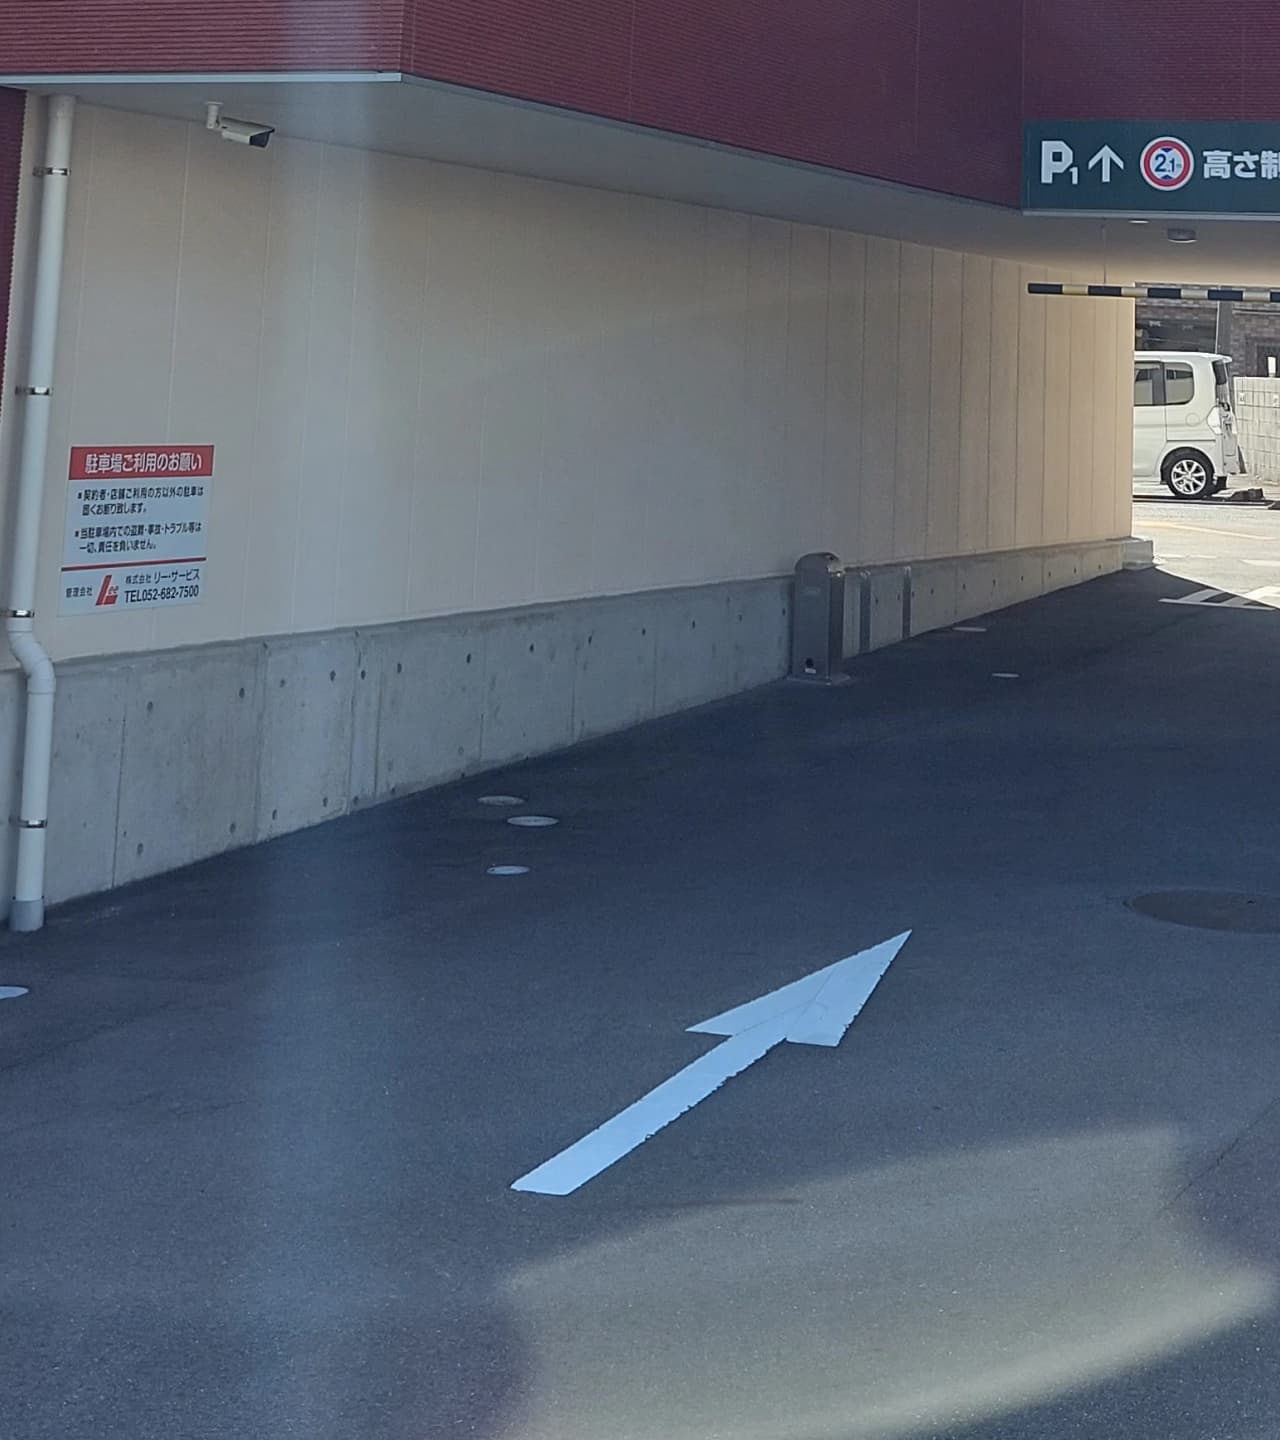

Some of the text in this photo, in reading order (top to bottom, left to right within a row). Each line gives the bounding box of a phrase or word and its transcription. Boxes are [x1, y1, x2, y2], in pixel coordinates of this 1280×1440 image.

[85, 452, 202, 474] 駐車場ご利用のお願い
